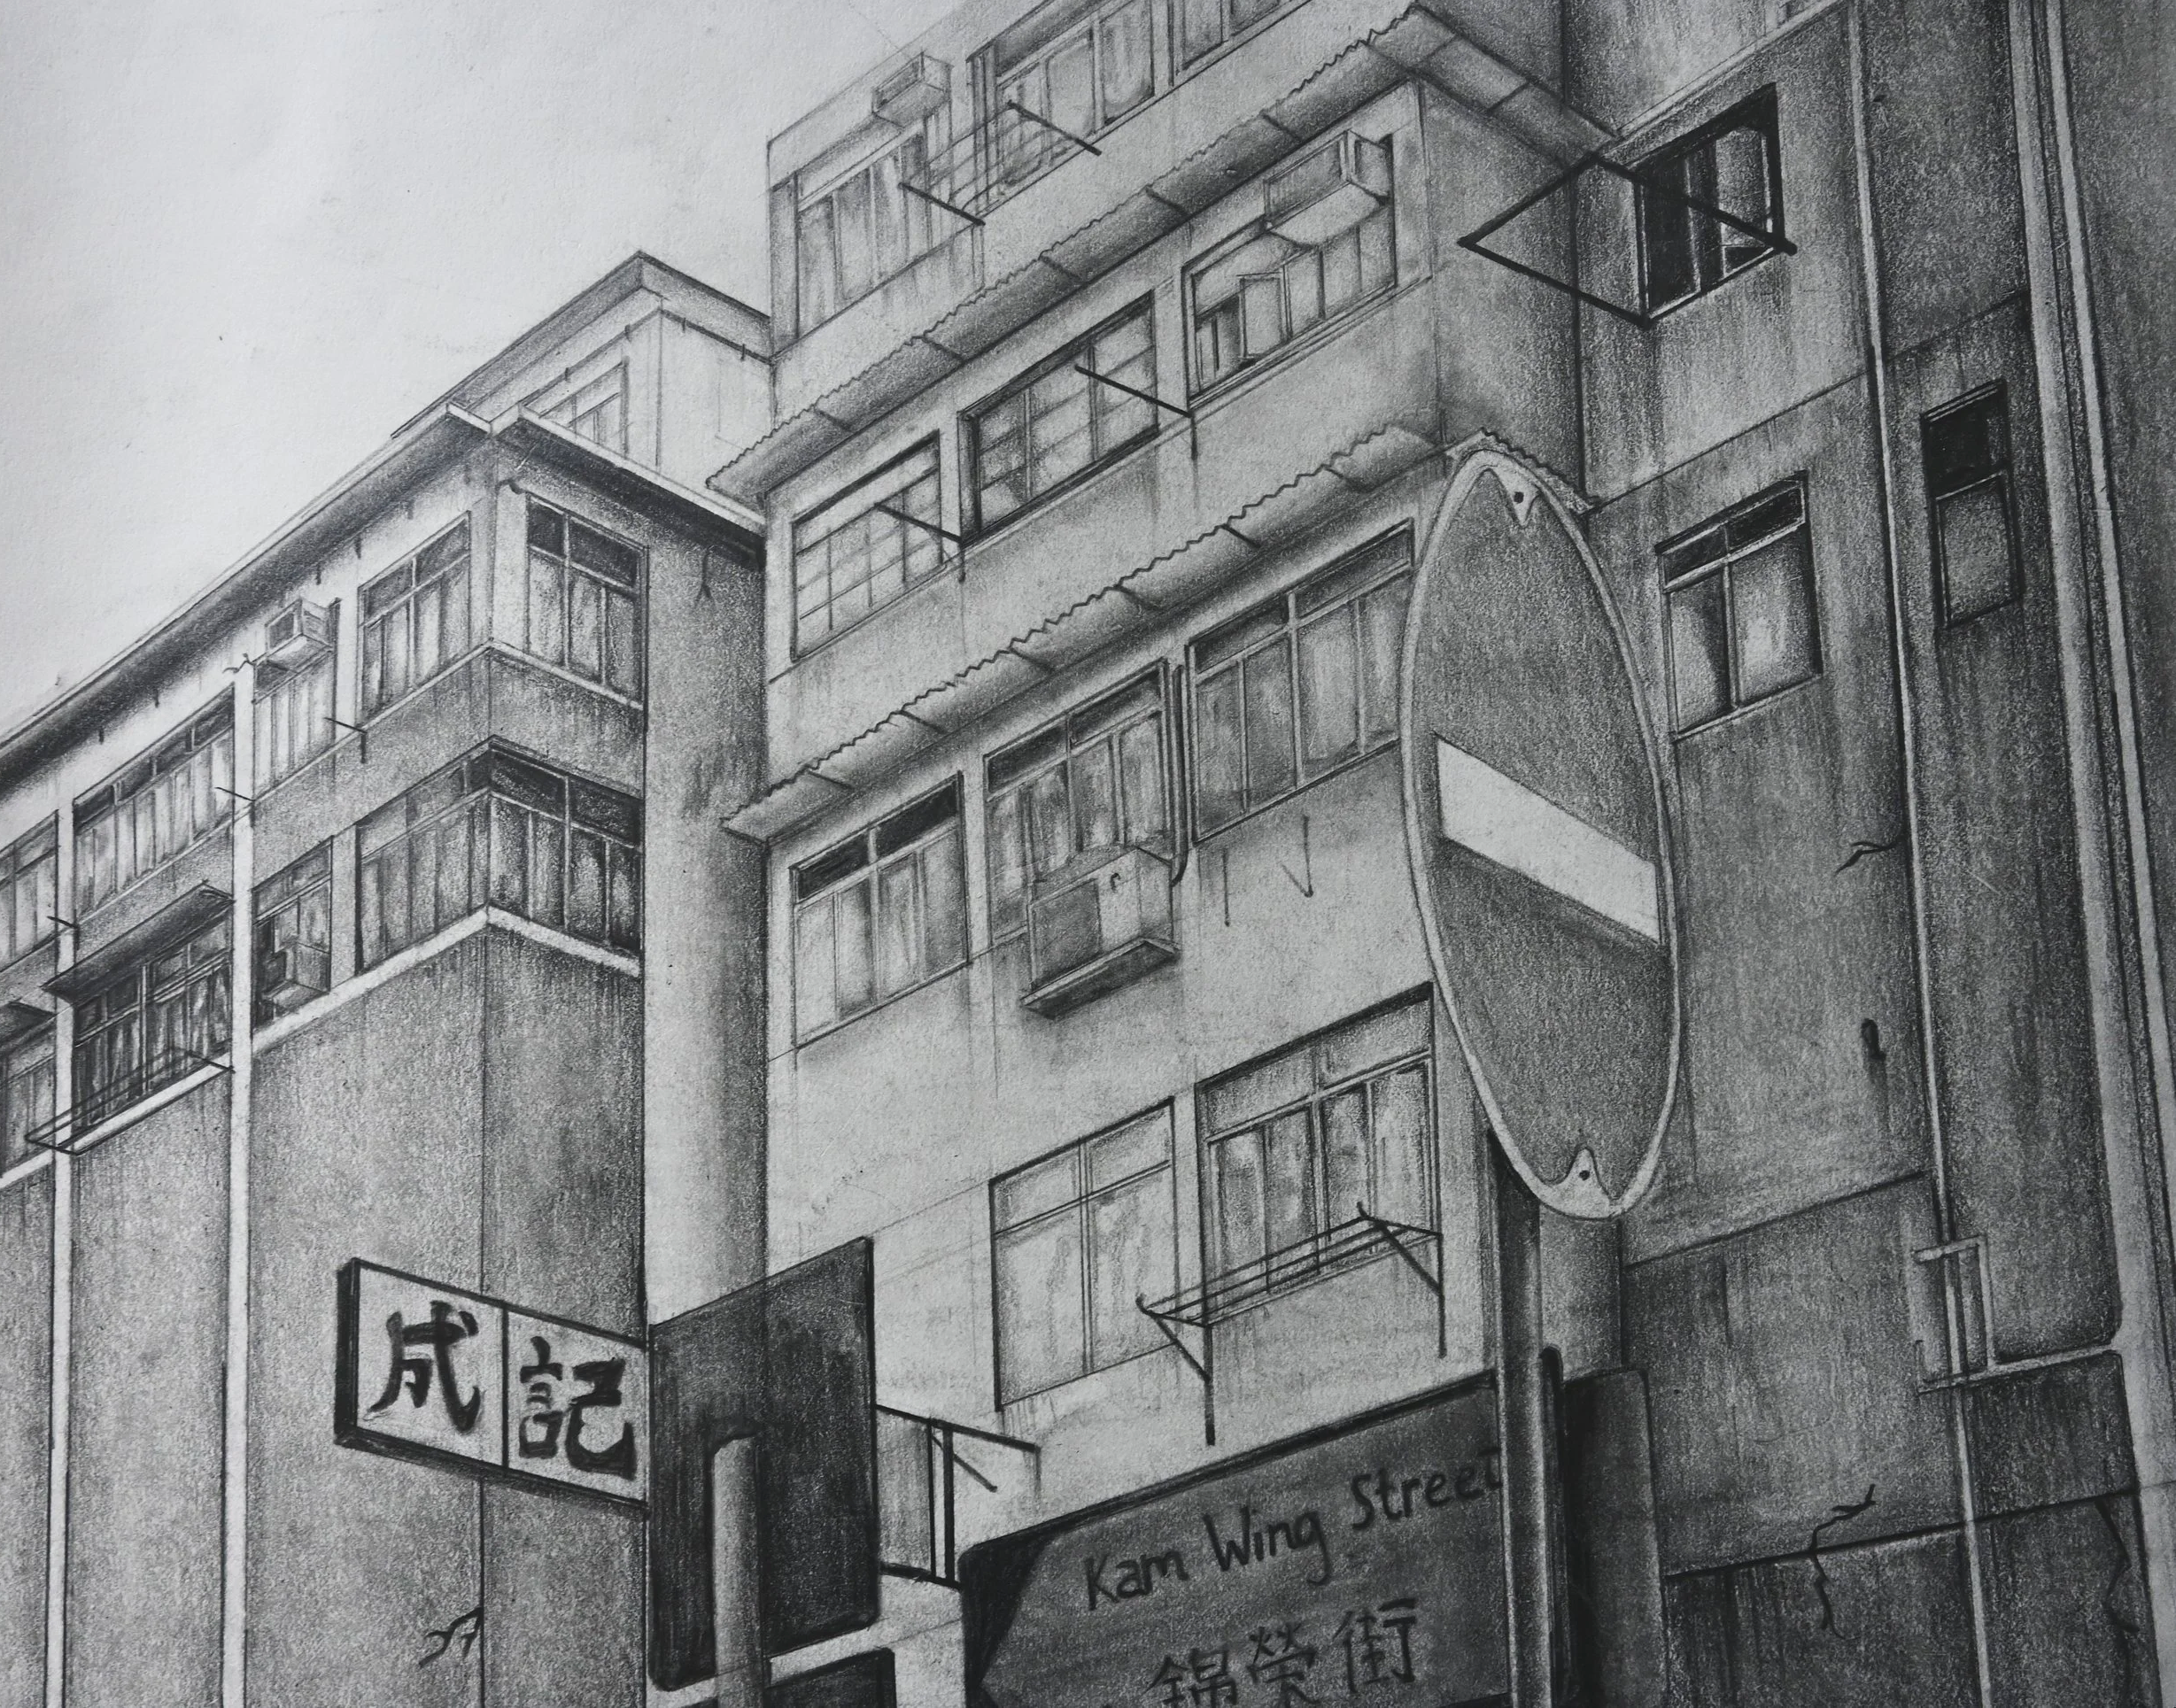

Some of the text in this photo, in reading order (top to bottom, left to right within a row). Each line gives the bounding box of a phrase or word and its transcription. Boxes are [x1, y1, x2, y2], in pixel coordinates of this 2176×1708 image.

[366, 1300, 638, 1481] 成記
[1083, 1446, 1504, 1611] Kam Wing Street
